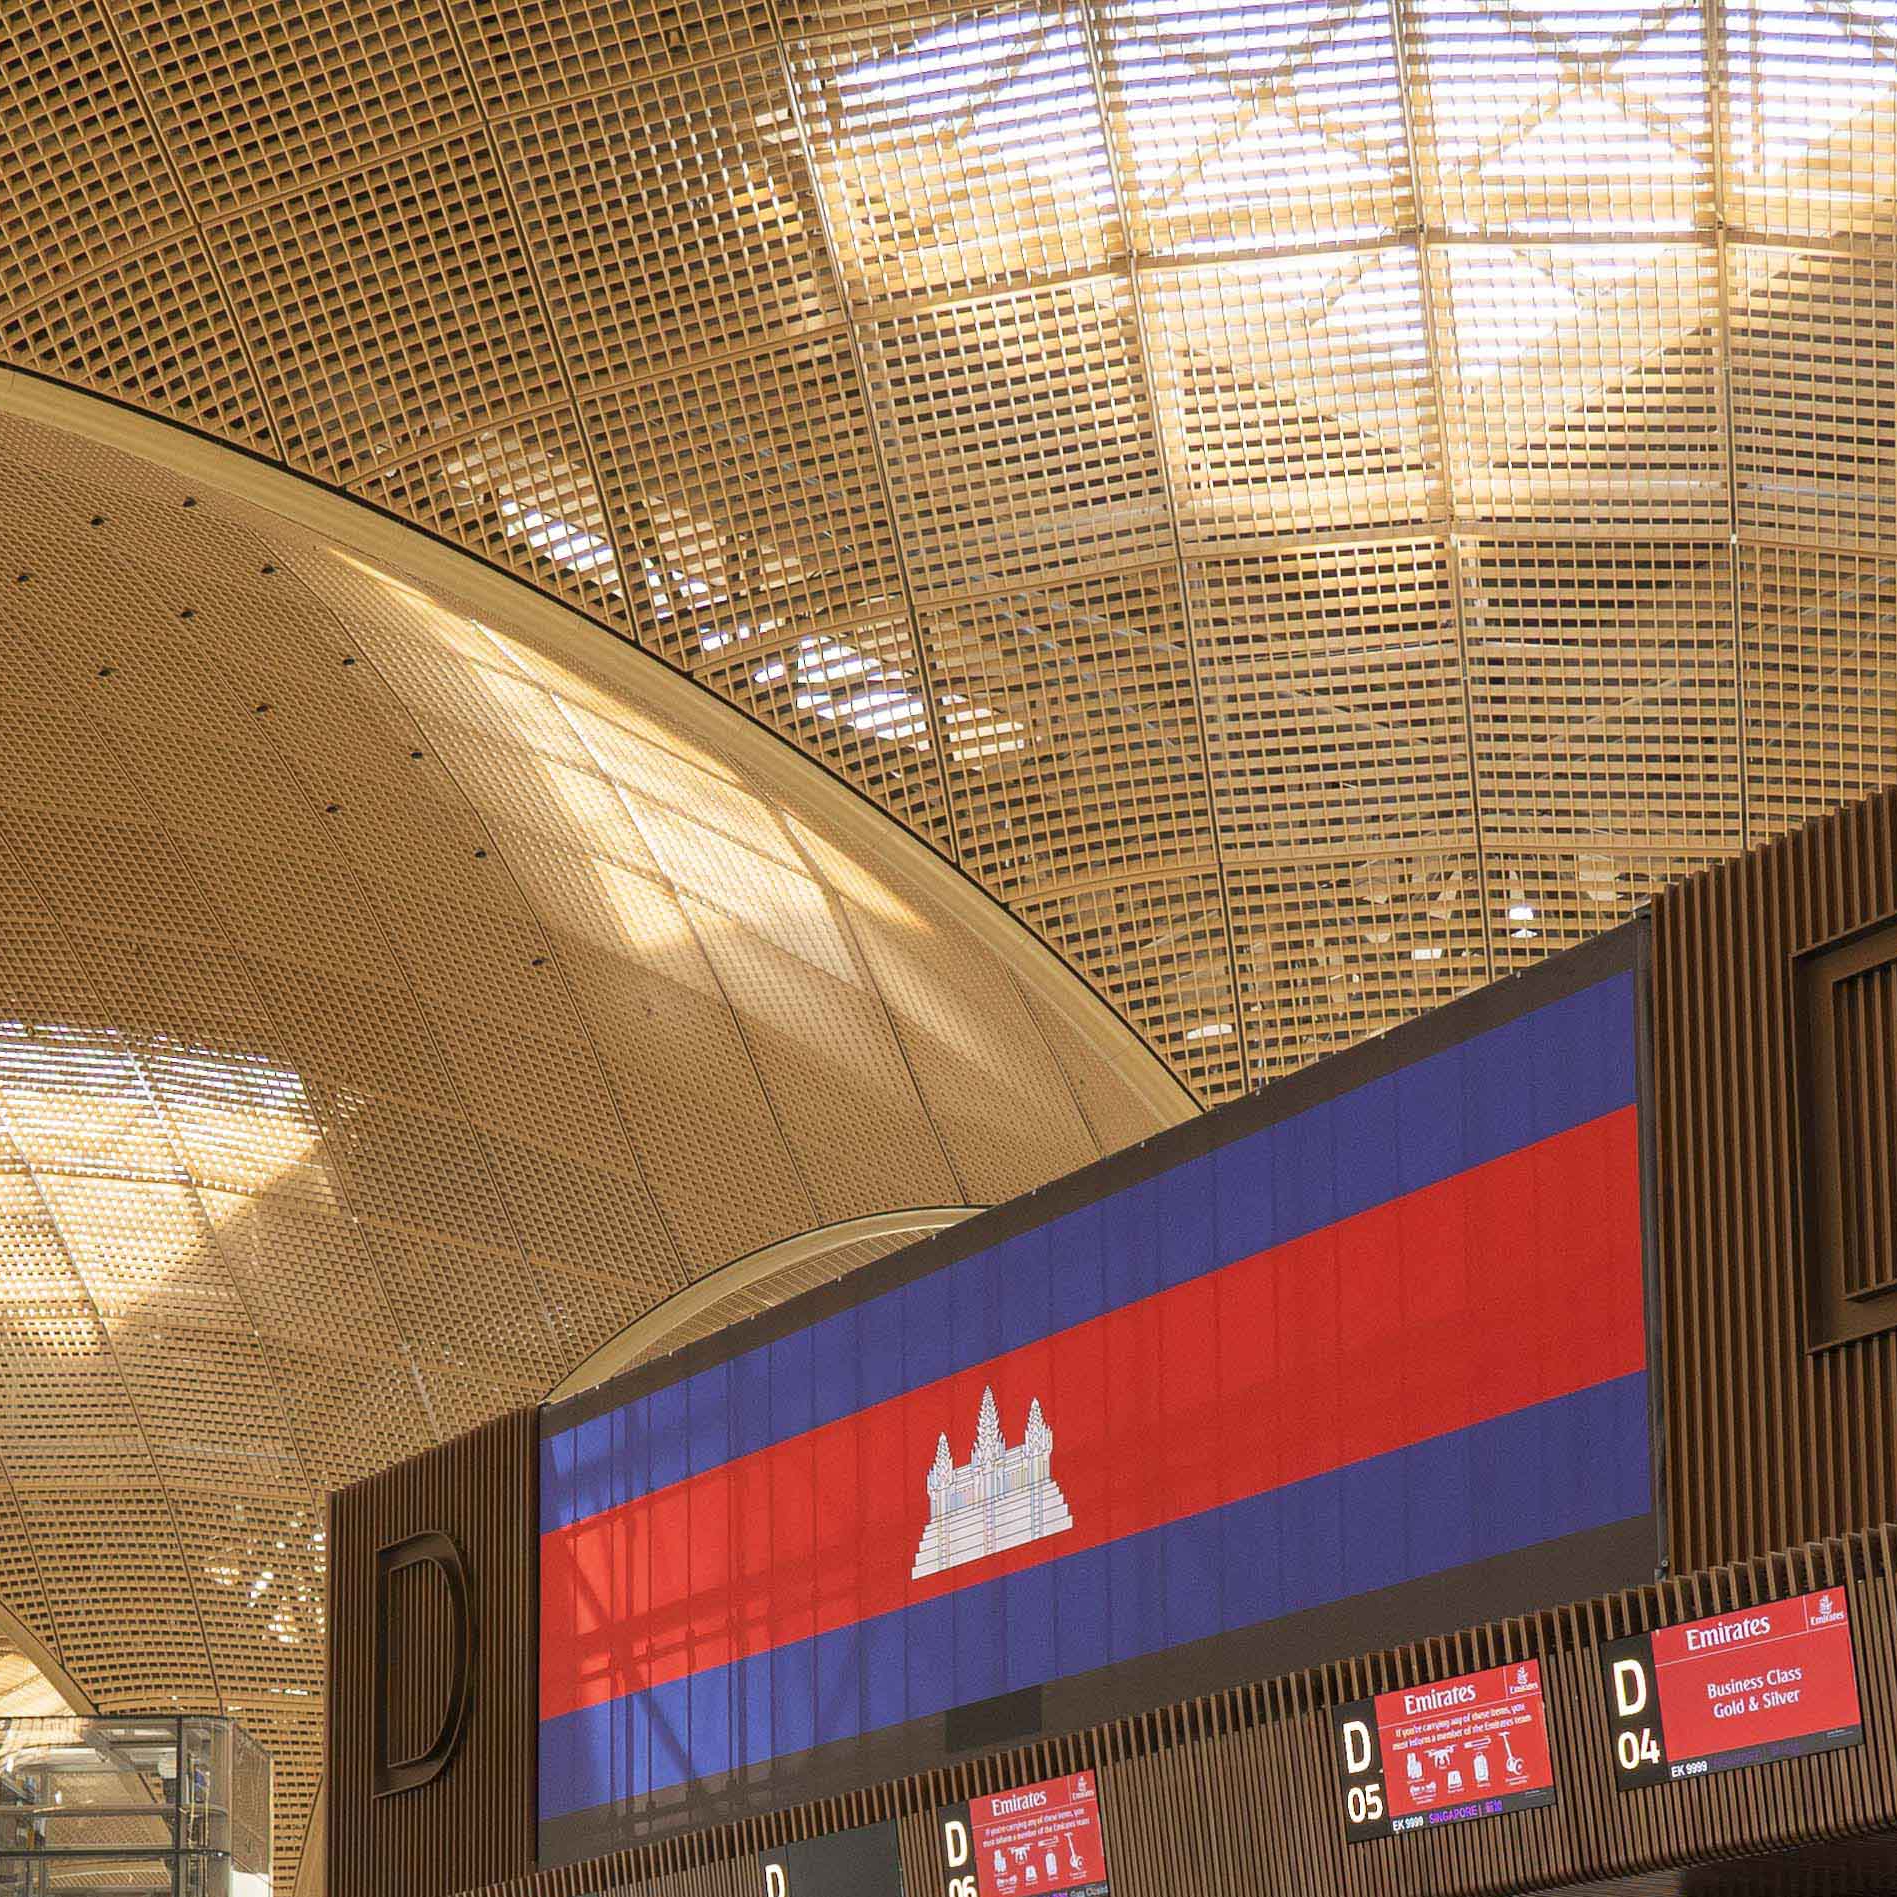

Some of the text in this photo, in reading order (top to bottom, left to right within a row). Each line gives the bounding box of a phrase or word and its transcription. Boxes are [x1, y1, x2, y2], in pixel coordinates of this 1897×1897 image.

[1686, 1616, 1771, 1651] Emirates
[374, 1530, 469, 1798] D
[1404, 1684, 1476, 1715] Emirates
[1613, 1658, 1647, 1716] D
[1708, 1667, 1802, 1699] Business Class
[1713, 1688, 1800, 1718] Gold & Silver
[1343, 1720, 1371, 1774] D
[1617, 1728, 1661, 1770] 04
[1671, 1764, 1686, 1778] EK
[991, 1791, 1047, 1817] Emirates
[1347, 1783, 1383, 1823] 05
[1393, 1820, 1404, 1831] EK
[1429, 1805, 1477, 1823] SINGAPORE
[945, 1820, 968, 1868] D
